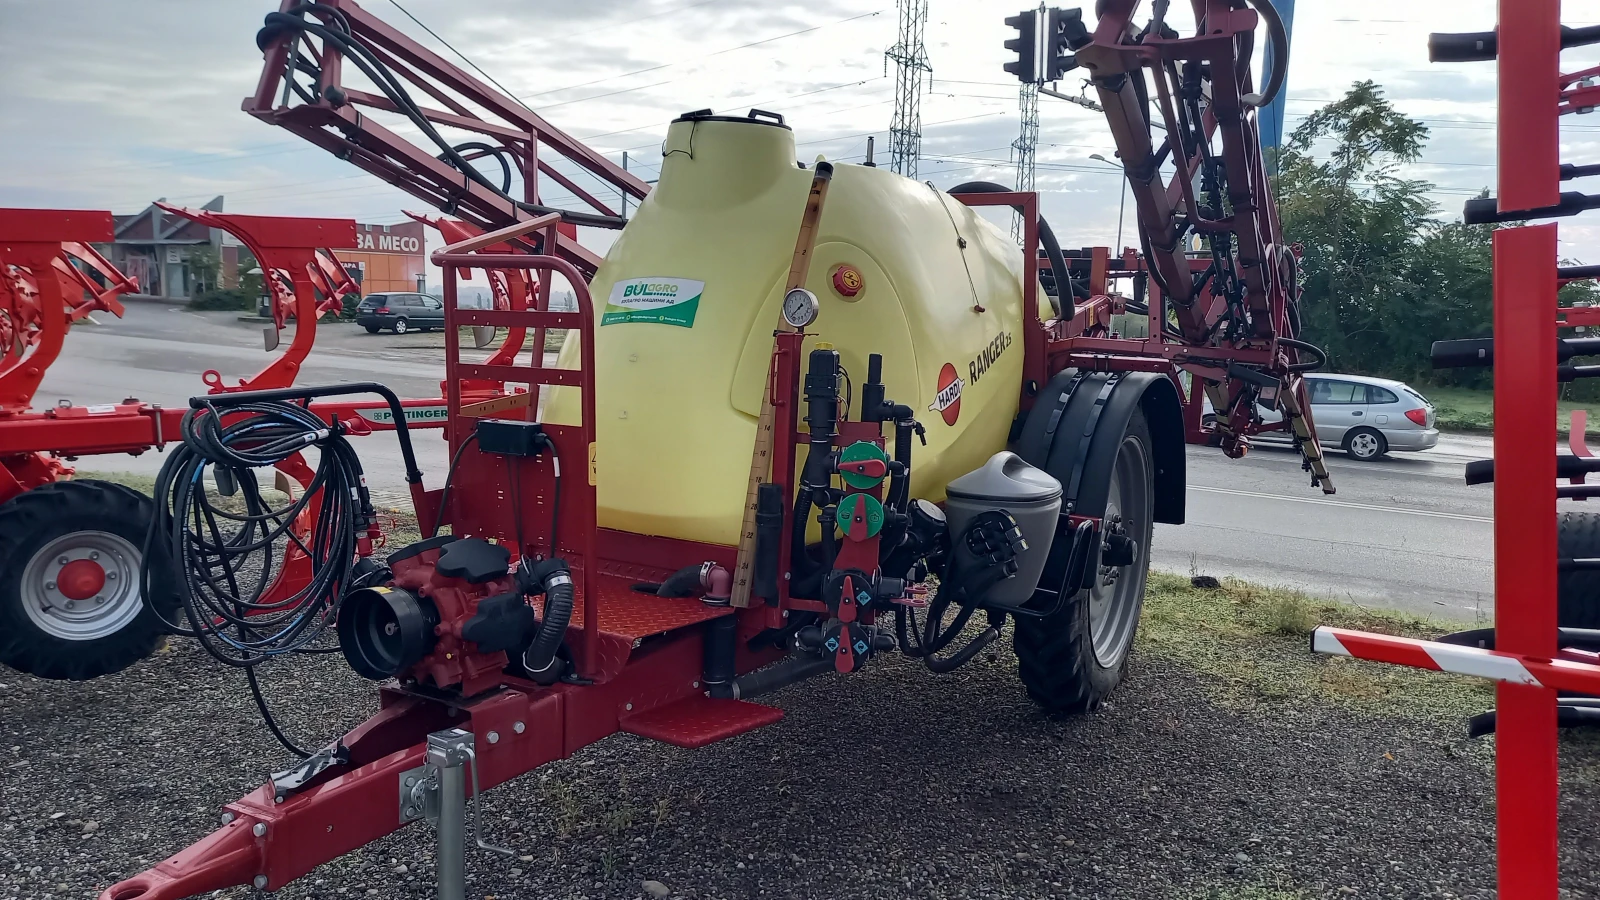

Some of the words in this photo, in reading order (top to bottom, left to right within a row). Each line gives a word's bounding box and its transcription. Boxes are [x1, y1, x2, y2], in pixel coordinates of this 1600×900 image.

[379, 235, 419, 252] МЕСО
[969, 331, 1006, 386] RANGER
[938, 380, 961, 409] HARDI
[384, 409, 448, 419] PTINGER
[746, 531, 754, 539] 22
